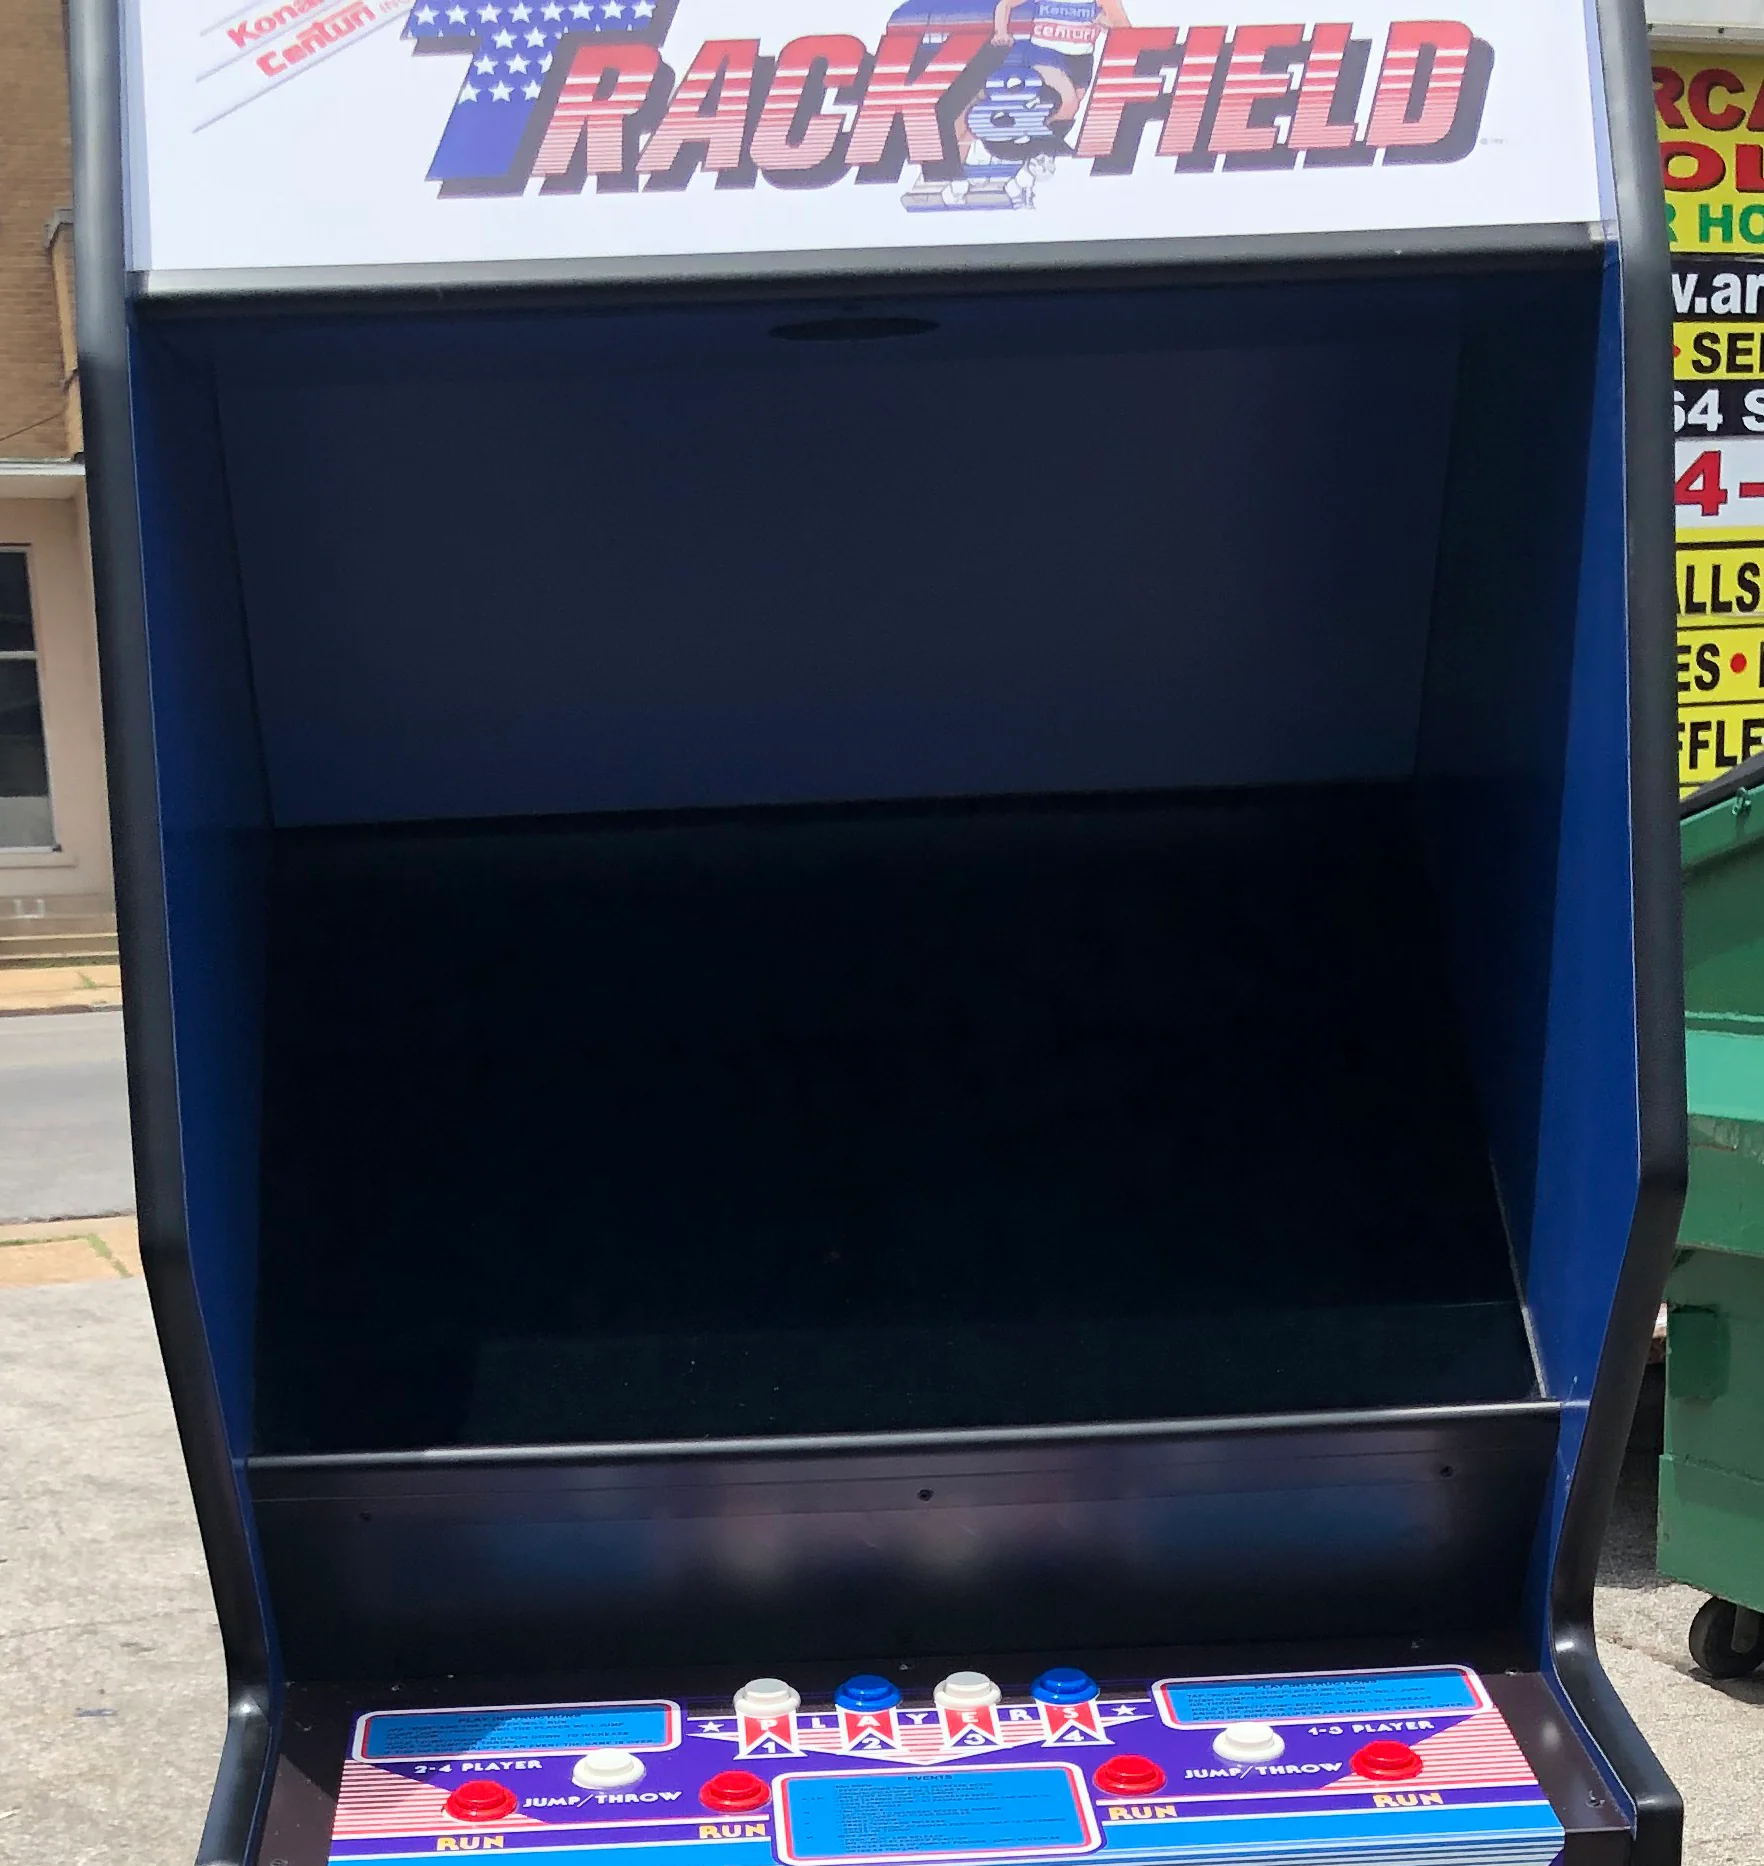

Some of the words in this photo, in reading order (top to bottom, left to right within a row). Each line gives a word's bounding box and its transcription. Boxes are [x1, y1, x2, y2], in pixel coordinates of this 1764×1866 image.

[400, 0, 997, 190] TRACK
[1075, 18, 1486, 166] FIELD
[1691, 331, 1764, 375] SE
[1677, 561, 1761, 614] LLS
[1352, 1719, 1436, 1734] PLAYER
[862, 1737, 882, 1750] 2
[963, 1732, 986, 1746] 3
[1062, 1728, 1084, 1743] 4
[762, 1741, 777, 1754] 1
[413, 1764, 453, 1775] 2-4
[461, 1759, 543, 1774] PLAYER
[1184, 1760, 1343, 1780] JUMP/THROW
[522, 1790, 684, 1809] JUMP/THROW
[1373, 1792, 1445, 1809] RUN
[1108, 1804, 1179, 1821] RUN
[699, 1822, 767, 1840] RUN
[436, 1835, 505, 1852] RUN
